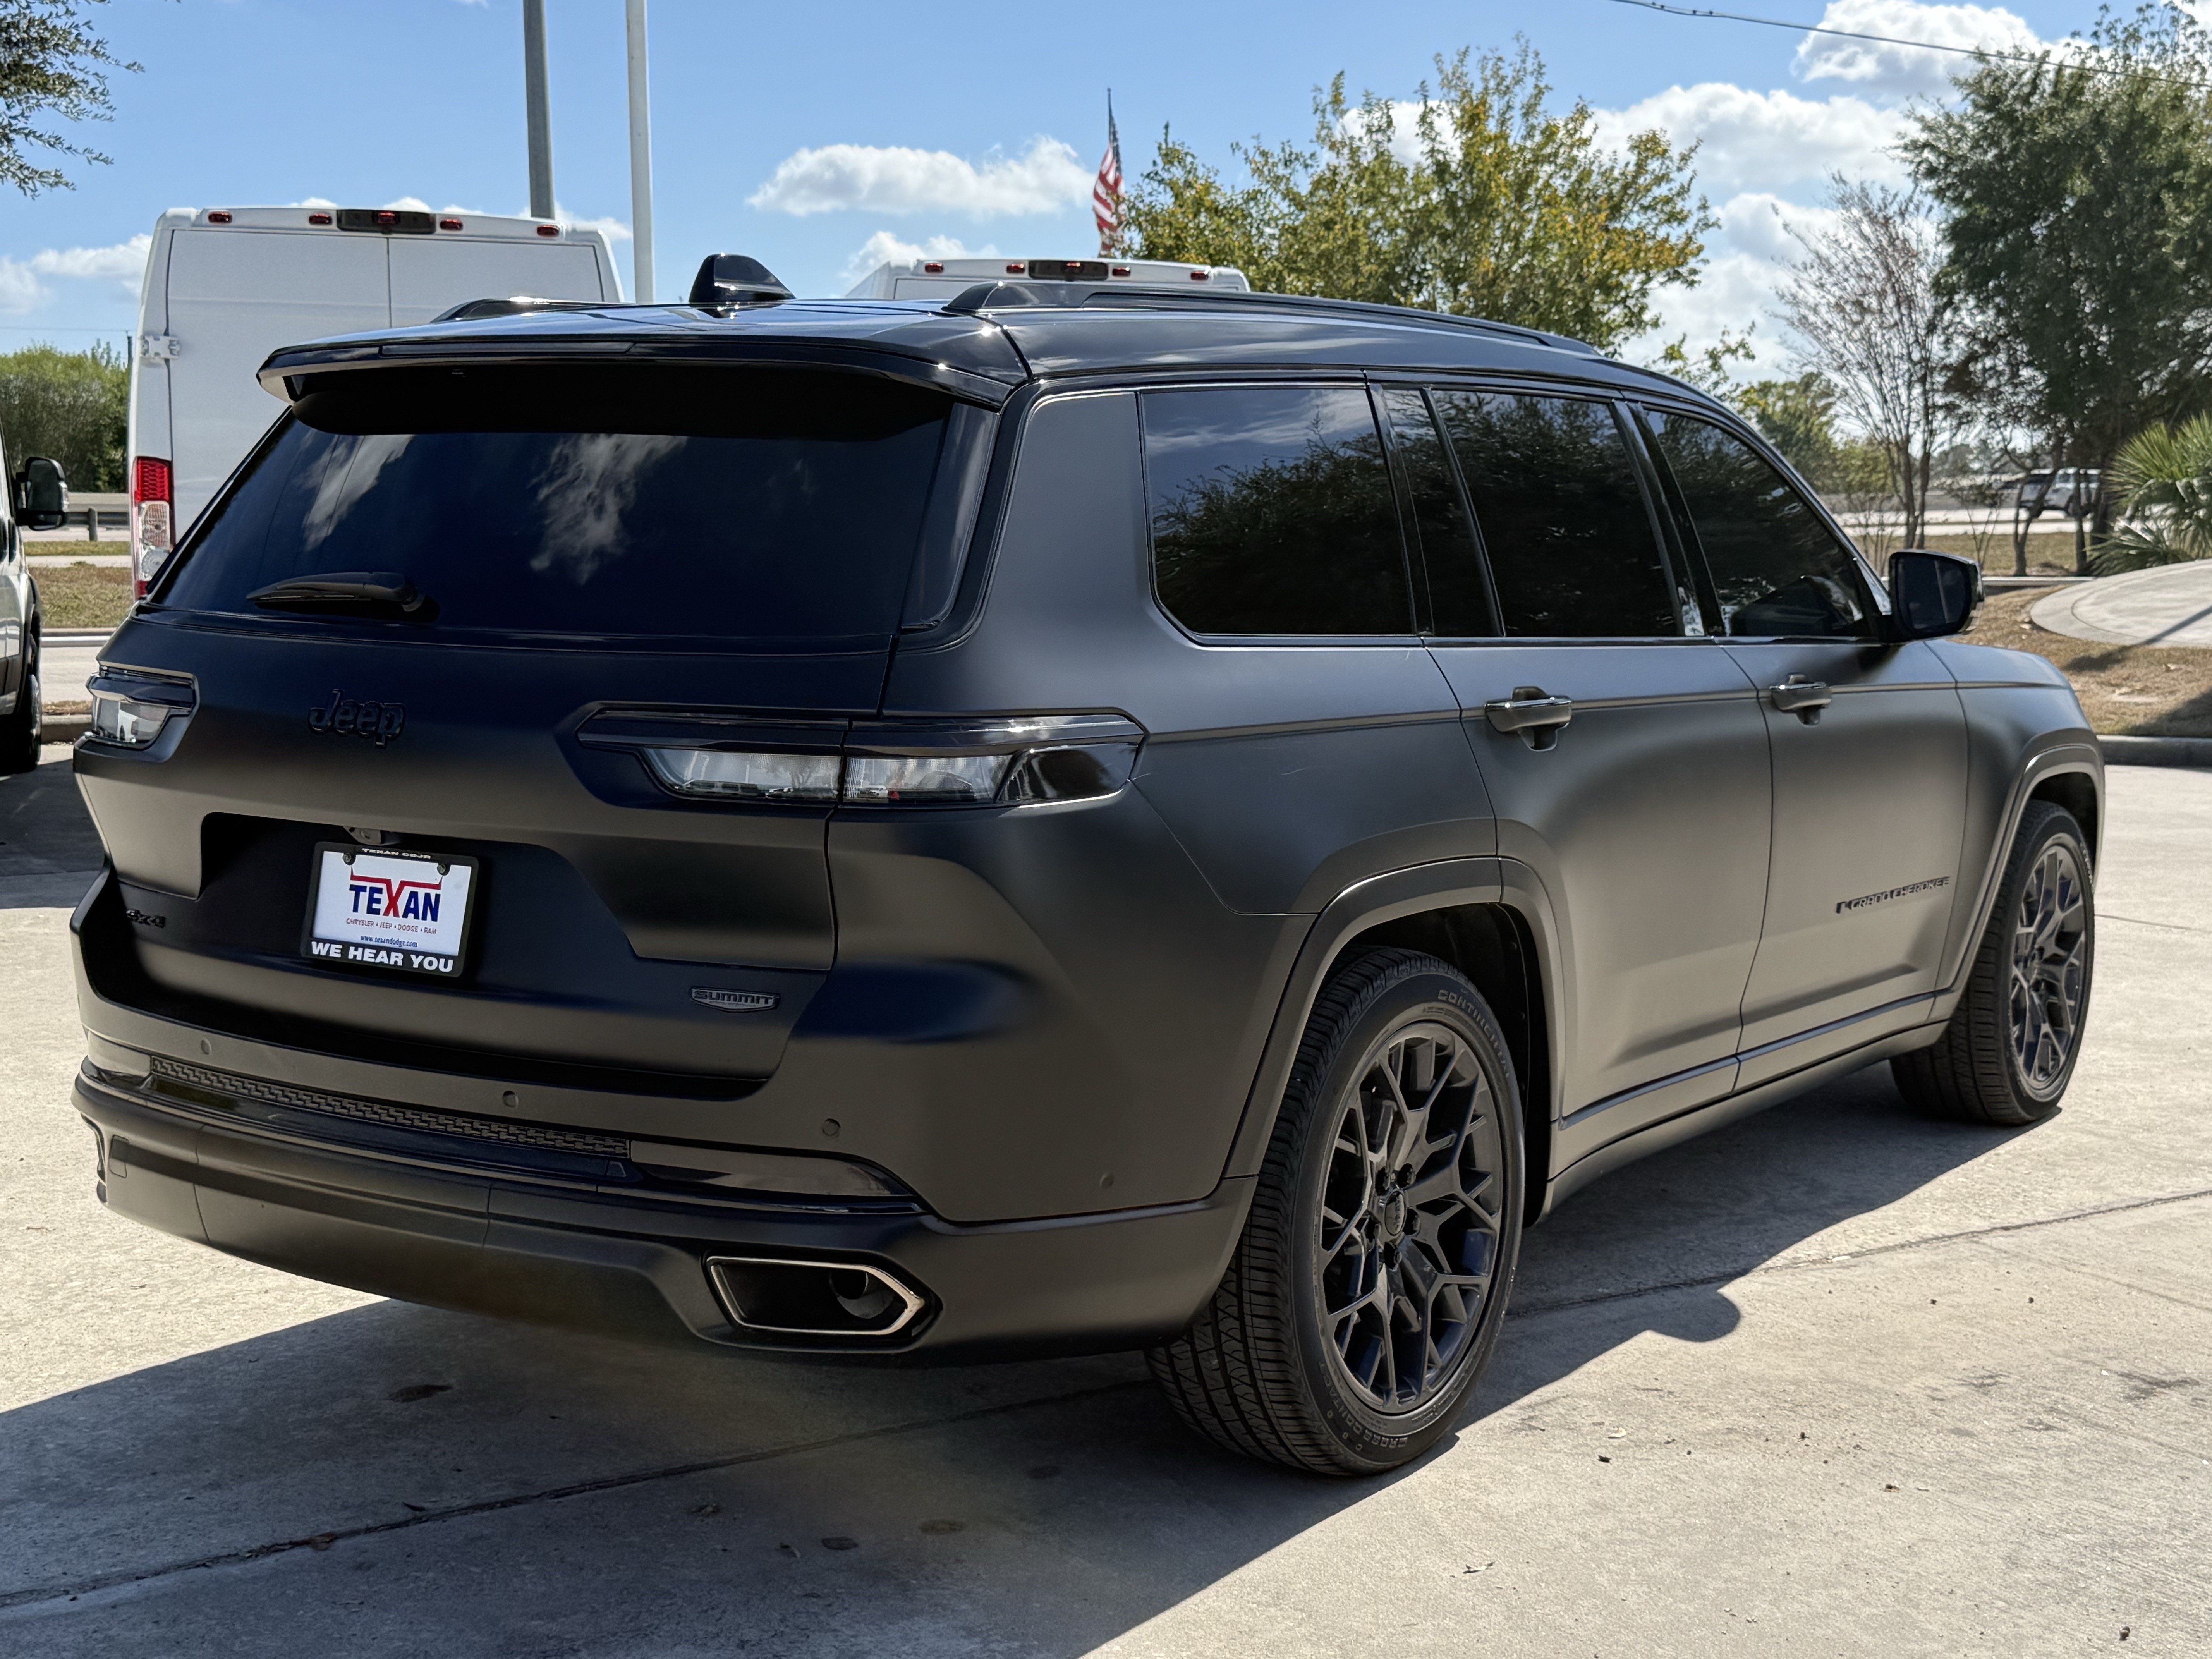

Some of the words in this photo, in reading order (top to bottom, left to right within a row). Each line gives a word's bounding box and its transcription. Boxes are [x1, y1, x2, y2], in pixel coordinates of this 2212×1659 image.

[308, 688, 405, 748] Jeep
[349, 874, 442, 922] TEXAN
[346, 917, 374, 927] CHRYSLER
[397, 924, 419, 932] DODGE
[311, 941, 343, 958] WE
[348, 947, 404, 966] HEAR
[410, 956, 453, 972] YOU
[694, 990, 773, 1005] SUMMIT
